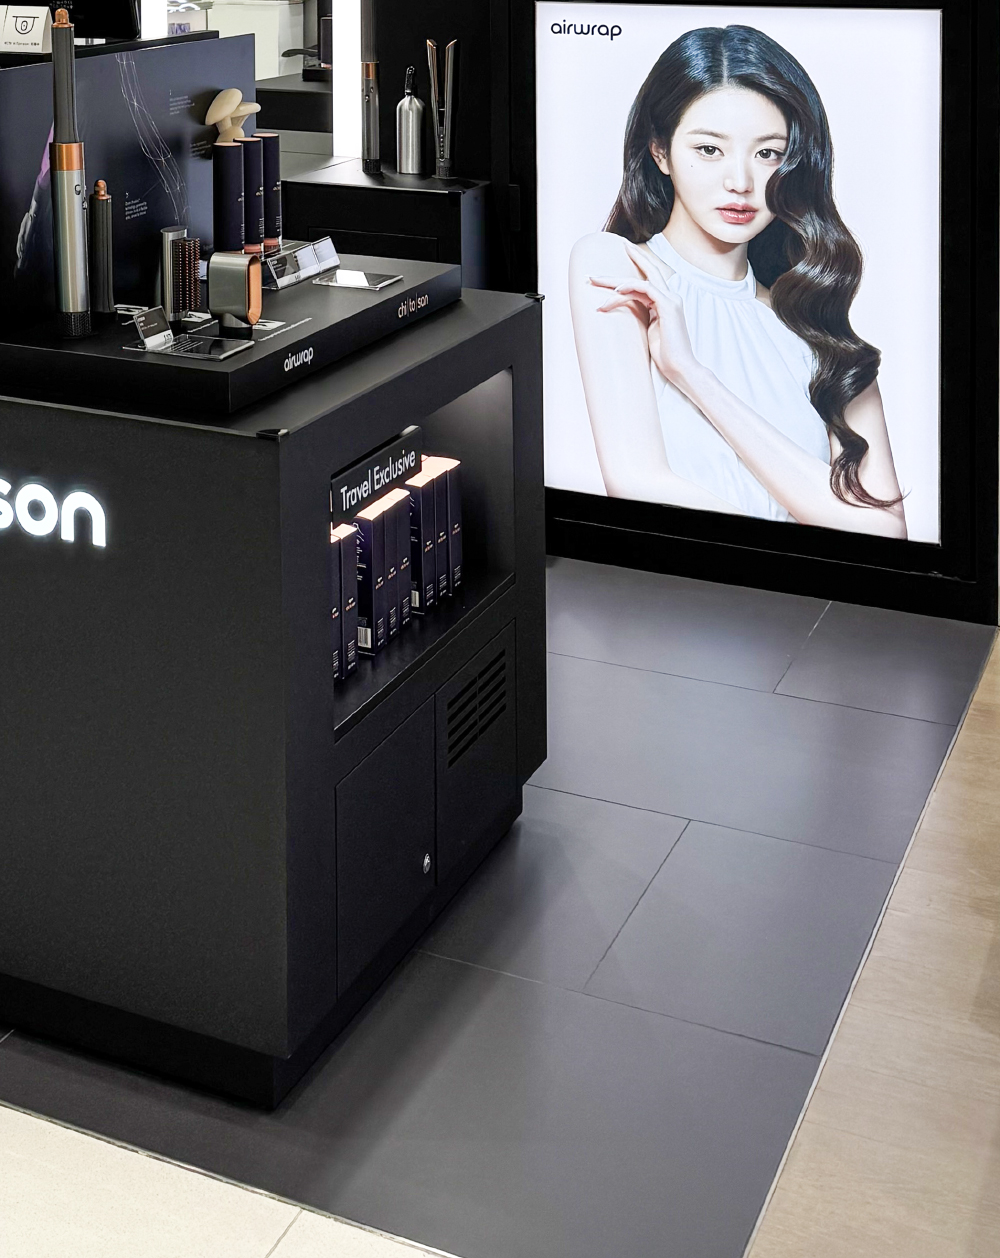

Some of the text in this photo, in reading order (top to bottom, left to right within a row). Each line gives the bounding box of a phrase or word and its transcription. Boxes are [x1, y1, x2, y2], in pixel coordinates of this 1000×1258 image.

[550, 19, 622, 41] airwrap
[284, 347, 314, 372] airwrap
[340, 449, 416, 511] Travel Exclusive
